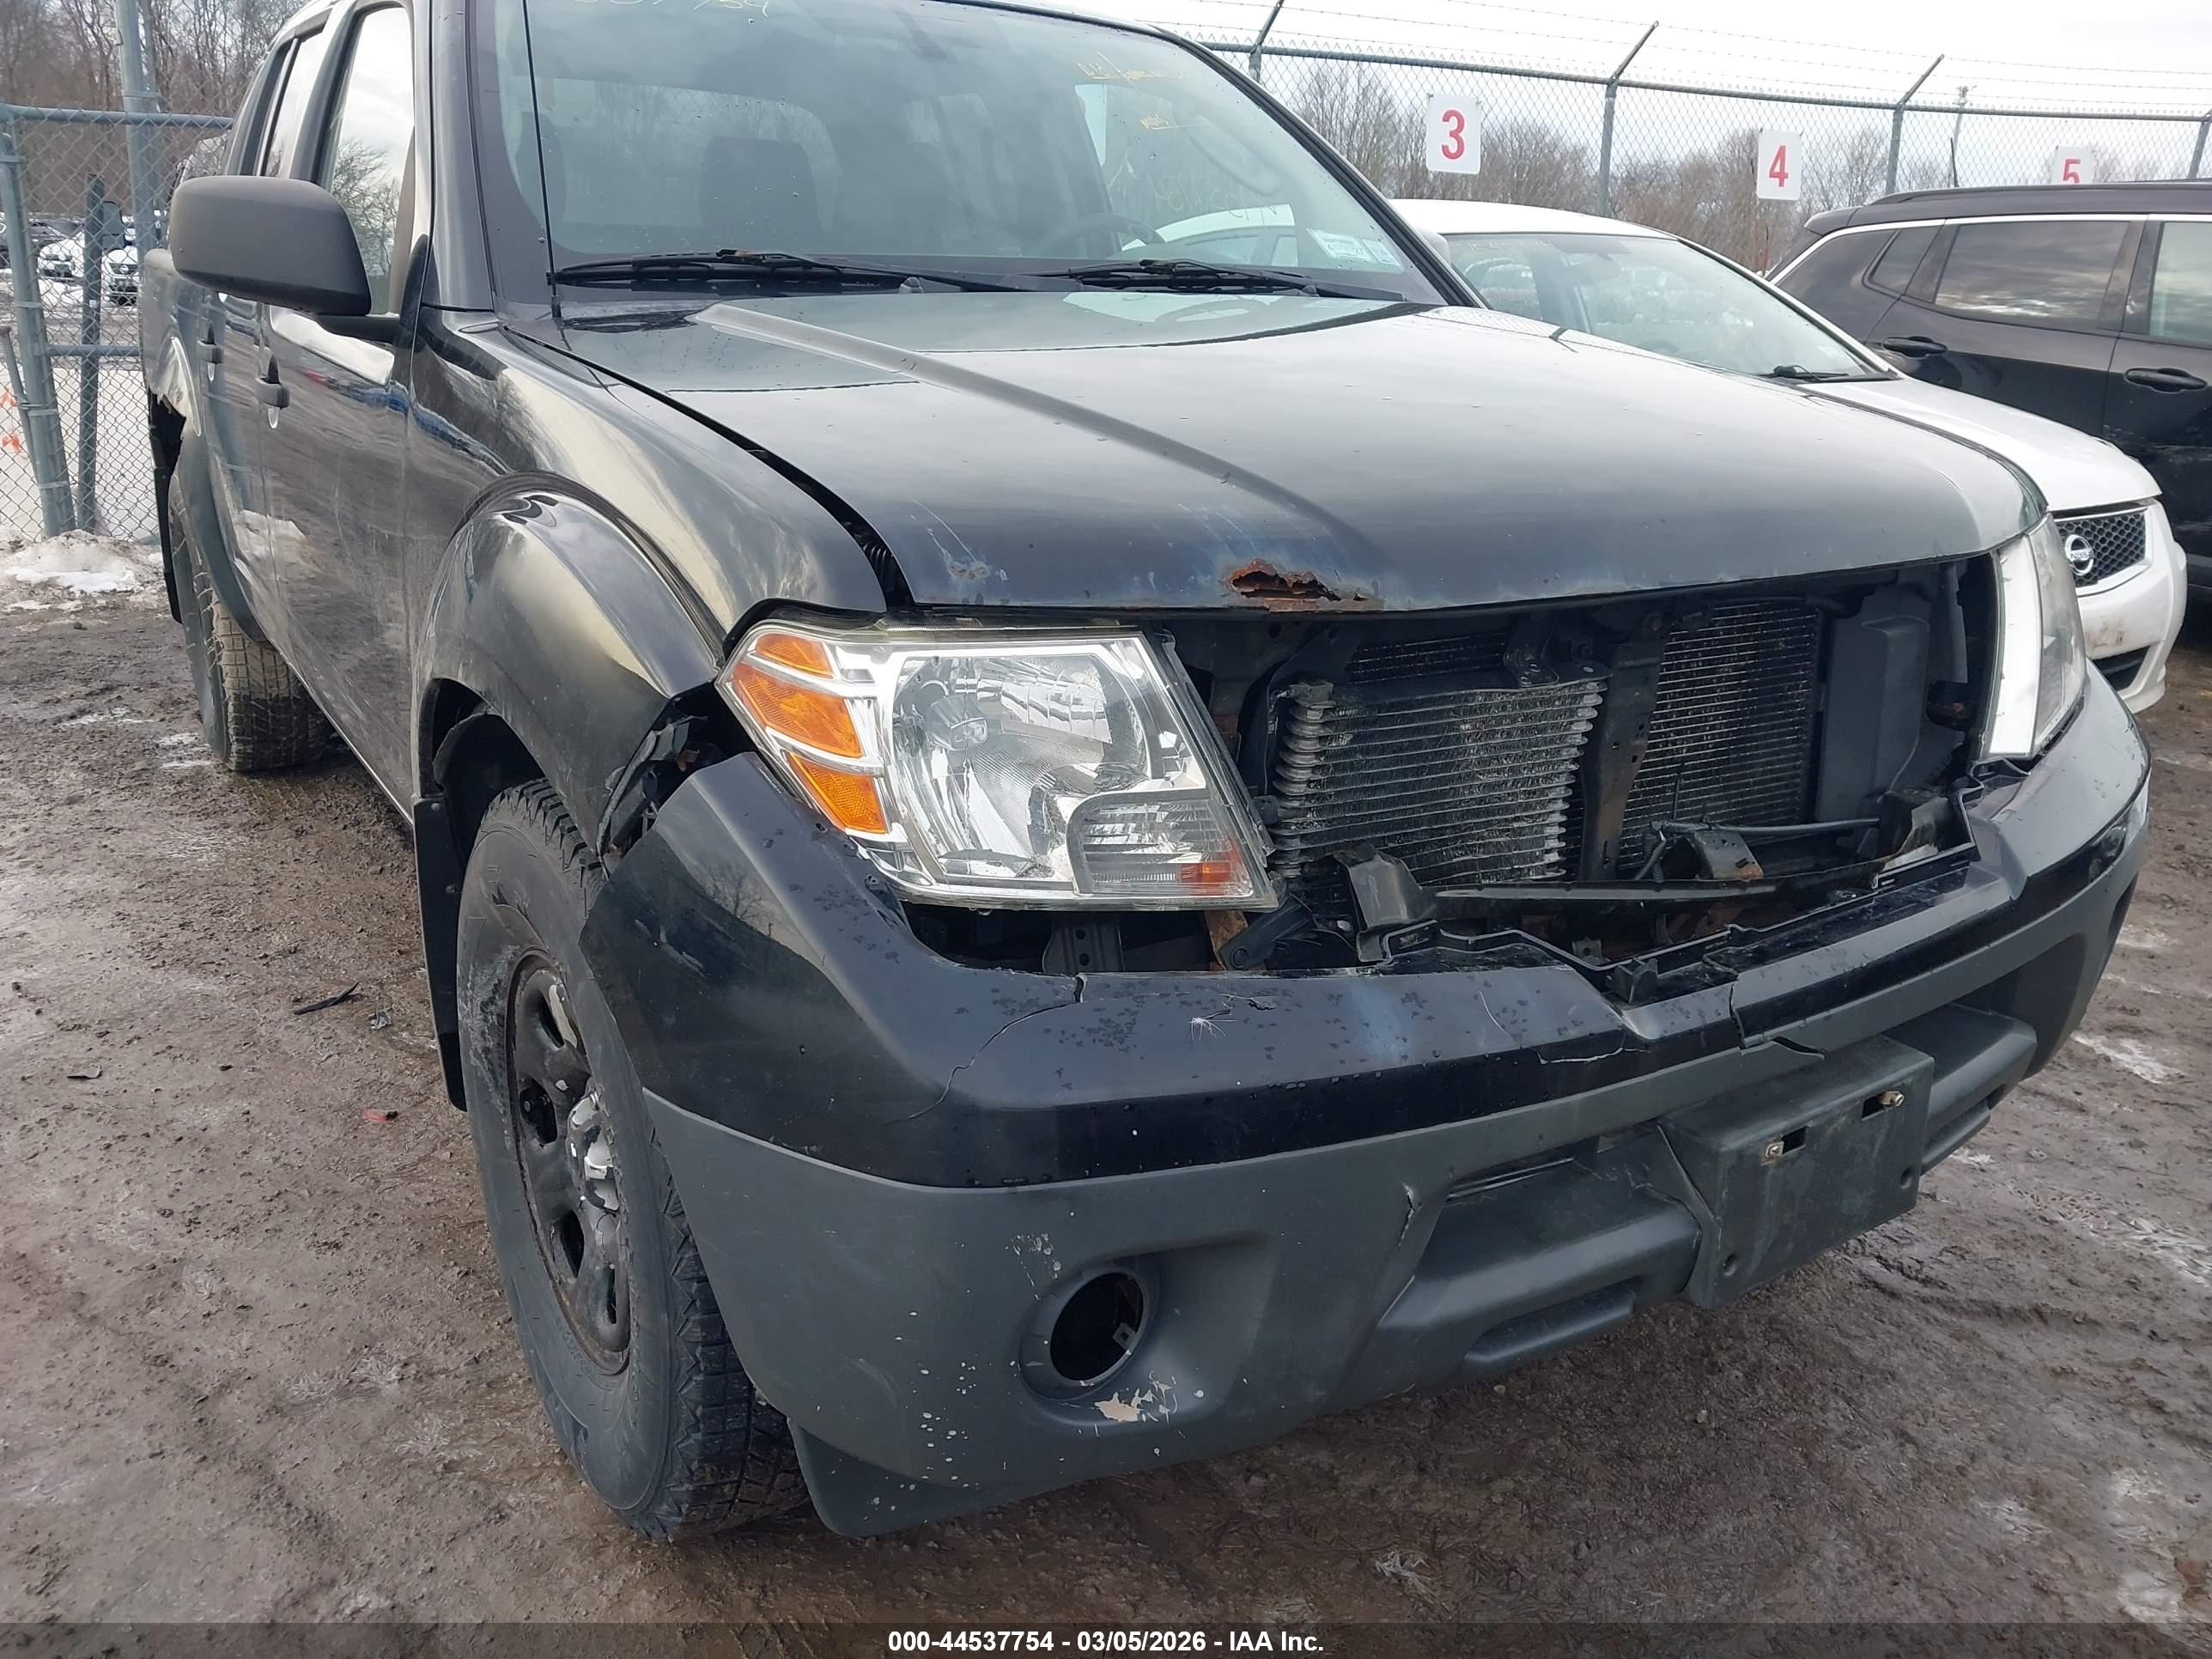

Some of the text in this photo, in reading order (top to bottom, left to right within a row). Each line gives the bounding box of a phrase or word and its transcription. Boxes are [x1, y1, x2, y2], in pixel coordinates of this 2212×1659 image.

[1441, 109, 1465, 160] 3
[1768, 144, 1790, 188] 4
[2062, 158, 2082, 185] 5
